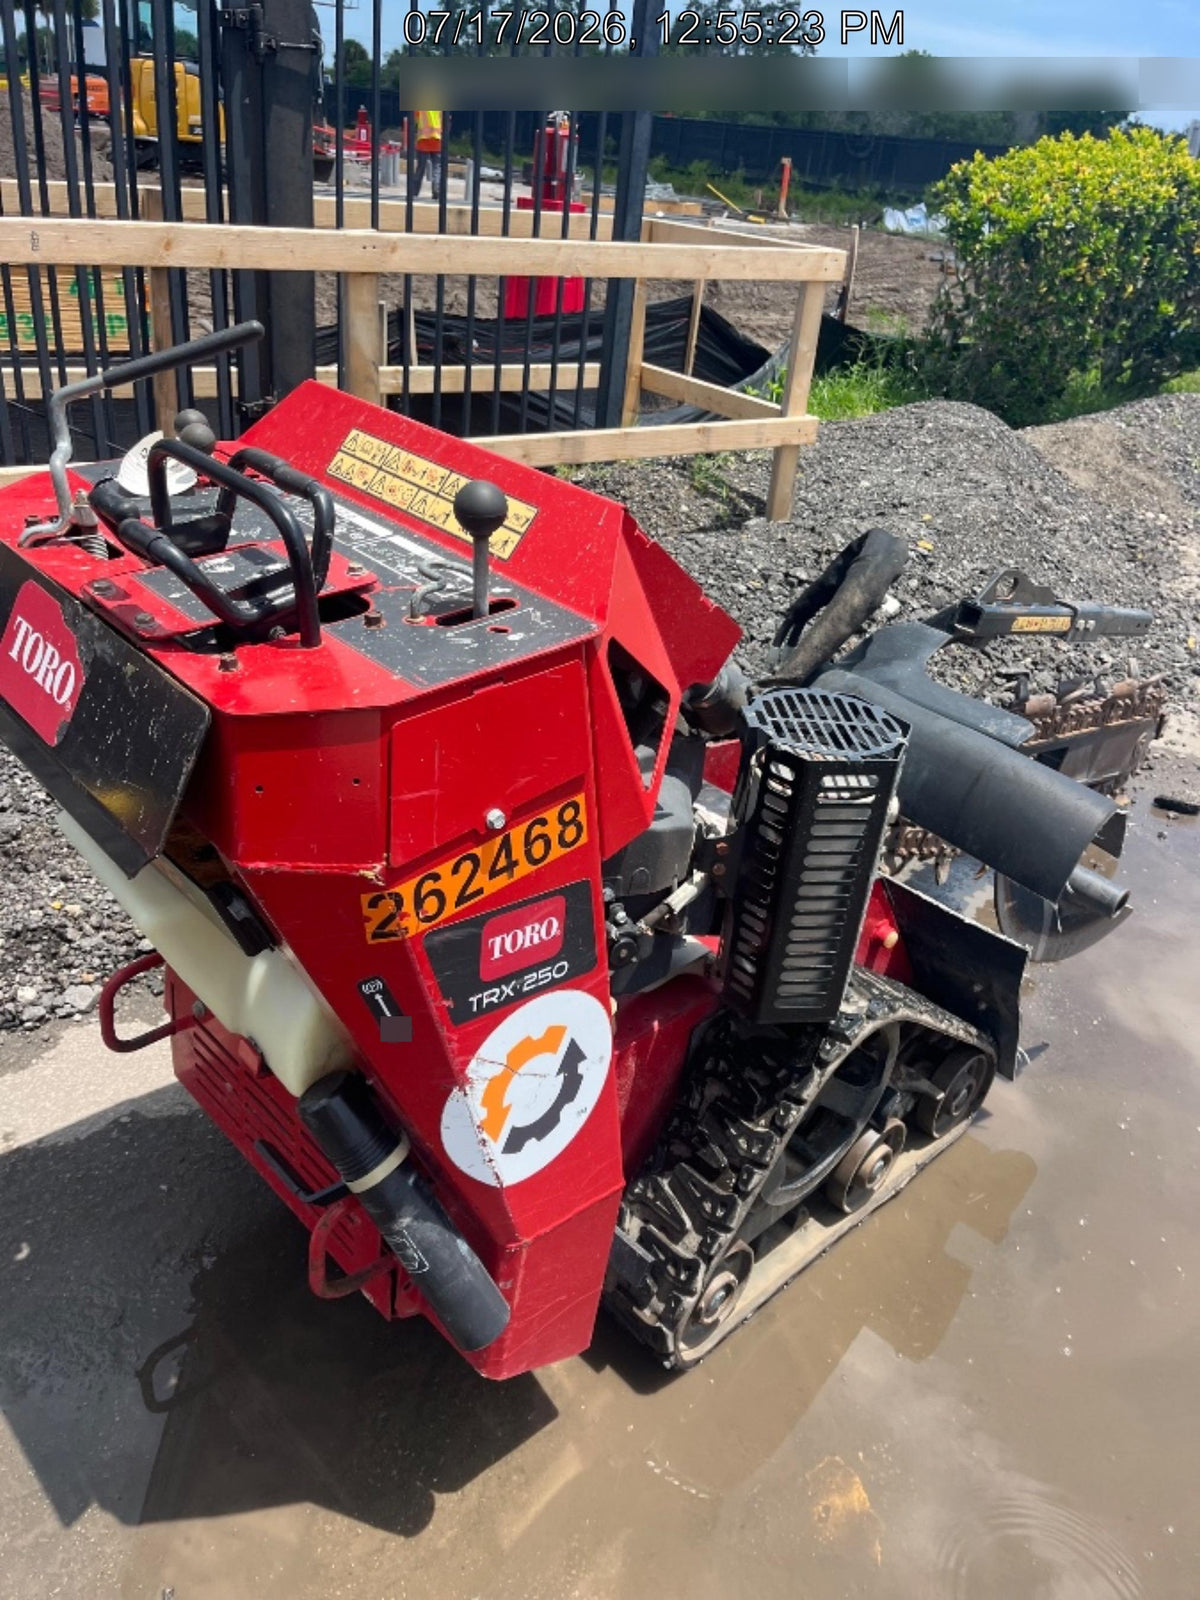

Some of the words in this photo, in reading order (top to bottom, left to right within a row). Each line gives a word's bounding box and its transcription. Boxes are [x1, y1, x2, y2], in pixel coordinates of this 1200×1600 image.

[9, 616, 75, 704] TORO
[367, 800, 584, 940] 262468
[488, 917, 559, 960] TORO
